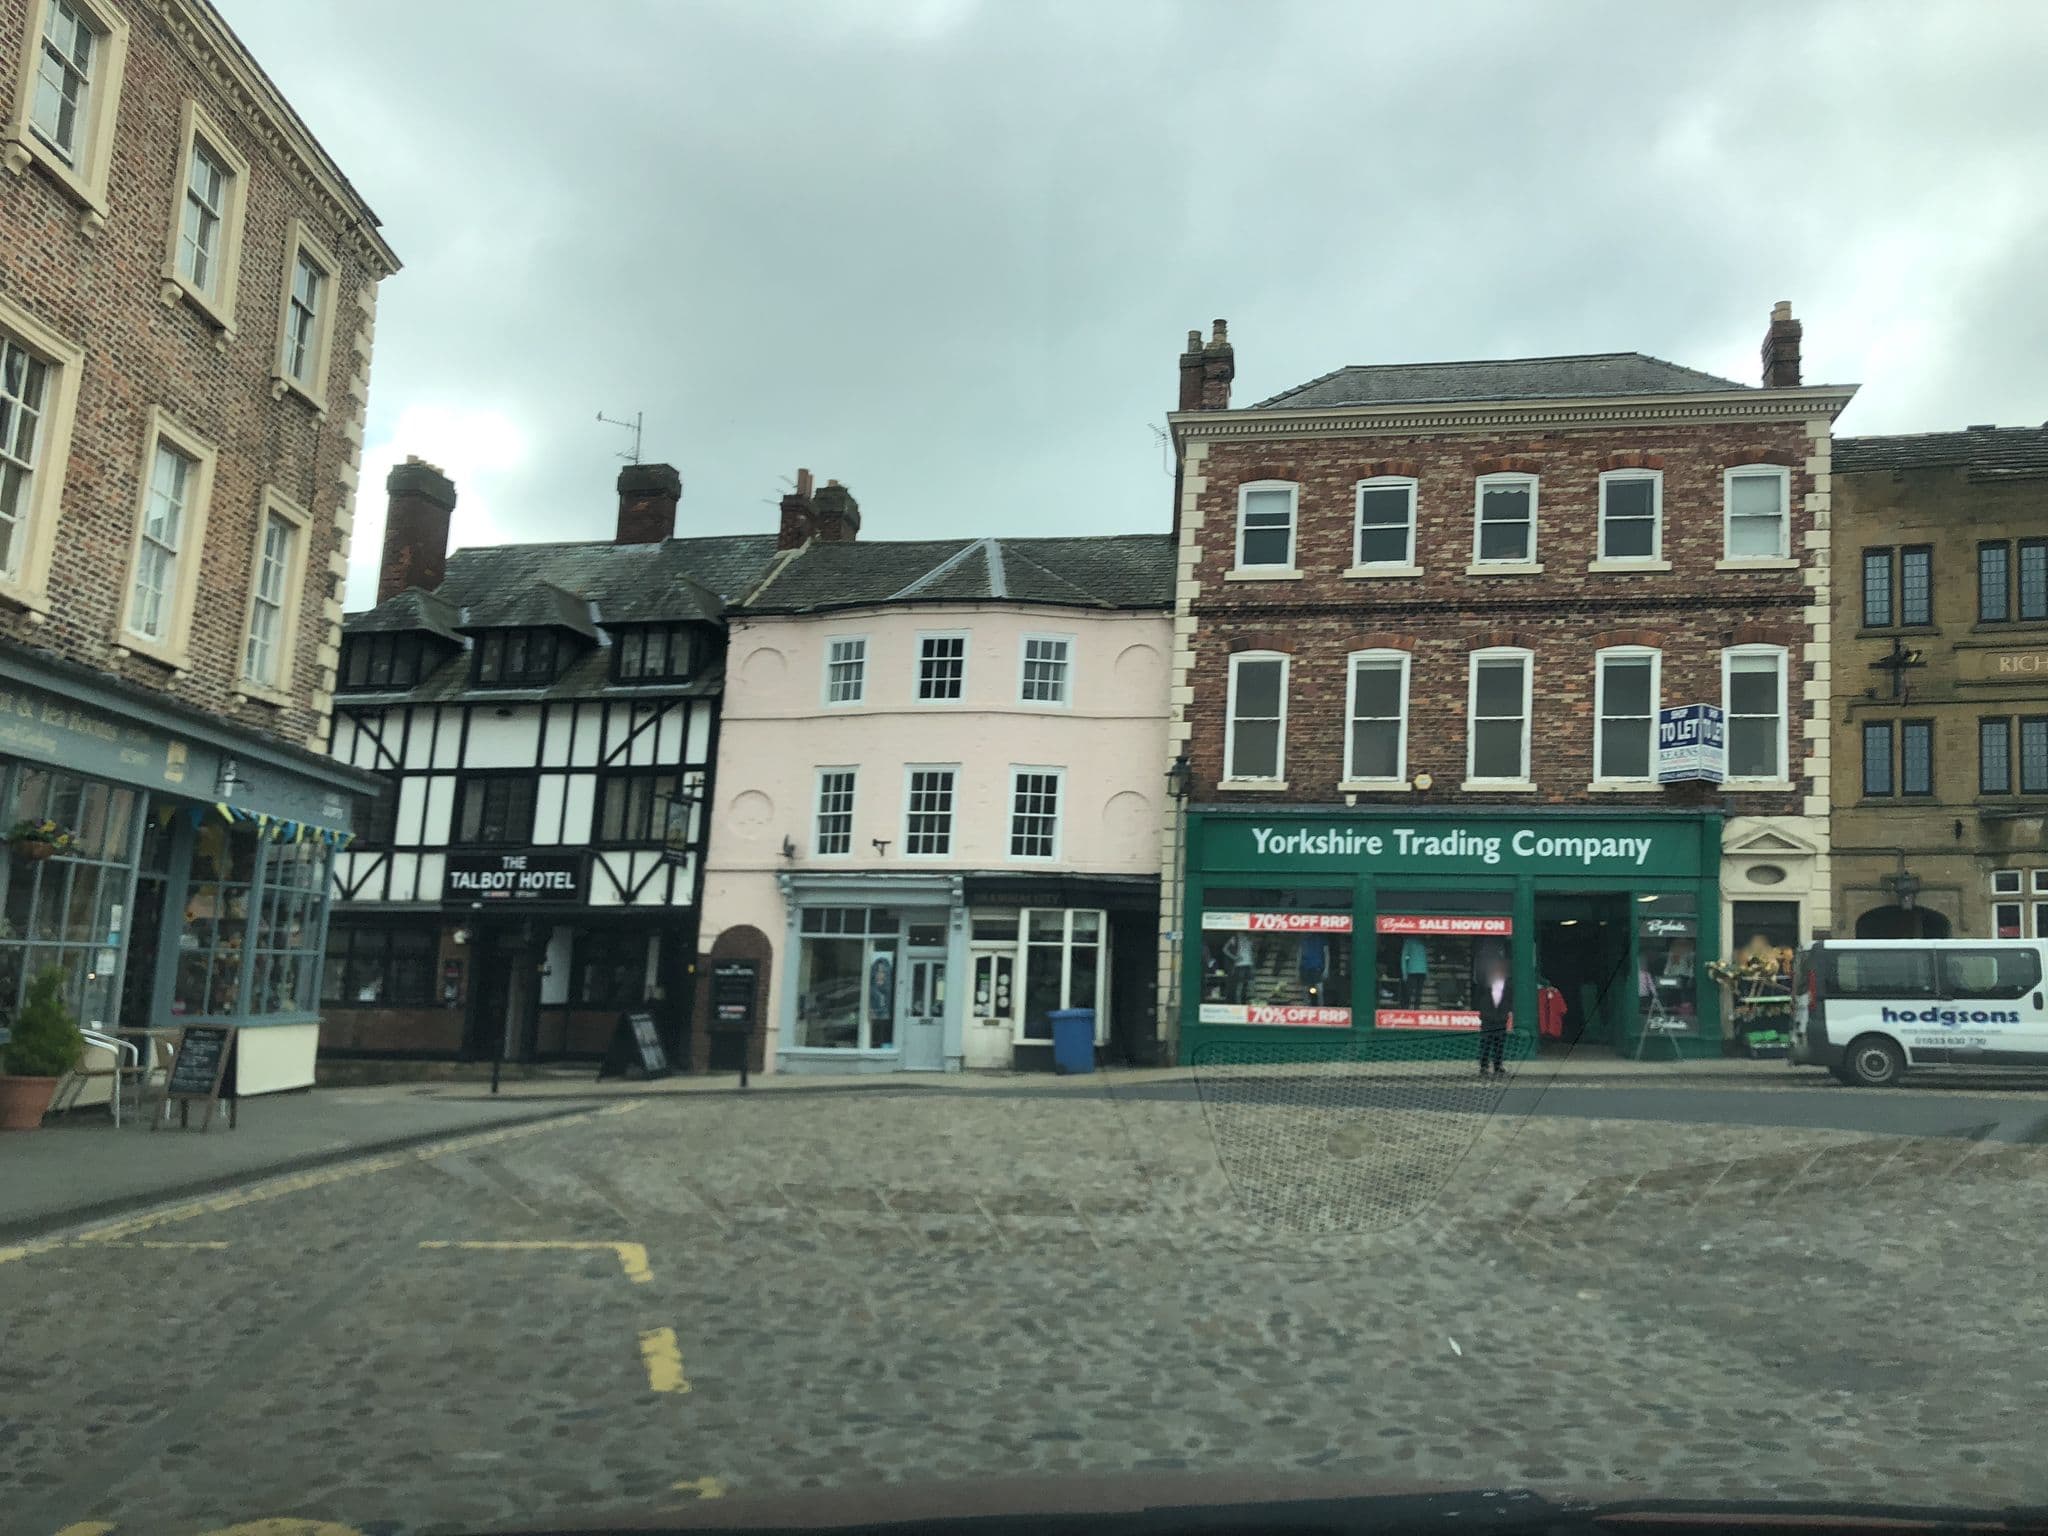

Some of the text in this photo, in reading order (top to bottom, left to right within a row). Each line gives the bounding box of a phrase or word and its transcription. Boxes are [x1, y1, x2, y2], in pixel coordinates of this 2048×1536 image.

[1660, 718, 1699, 743] TO LET
[1252, 827, 1652, 865] Yorkshire Trading Company
[502, 855, 528, 870] THE
[450, 871, 576, 890] TALBOT HOTEL
[1252, 913, 1289, 930] 70%
[1288, 914, 1318, 929] OFF
[1320, 915, 1350, 928] RRP
[1418, 919, 1450, 930] SALE
[1451, 919, 1484, 931] NOW
[1484, 920, 1506, 931] ON
[1252, 1006, 1287, 1024] 70%
[1287, 1009, 1318, 1022] OFF
[1319, 1010, 1349, 1023] RRP
[1418, 1014, 1450, 1026] SALE
[1881, 1006, 2021, 1027] hodgsons
